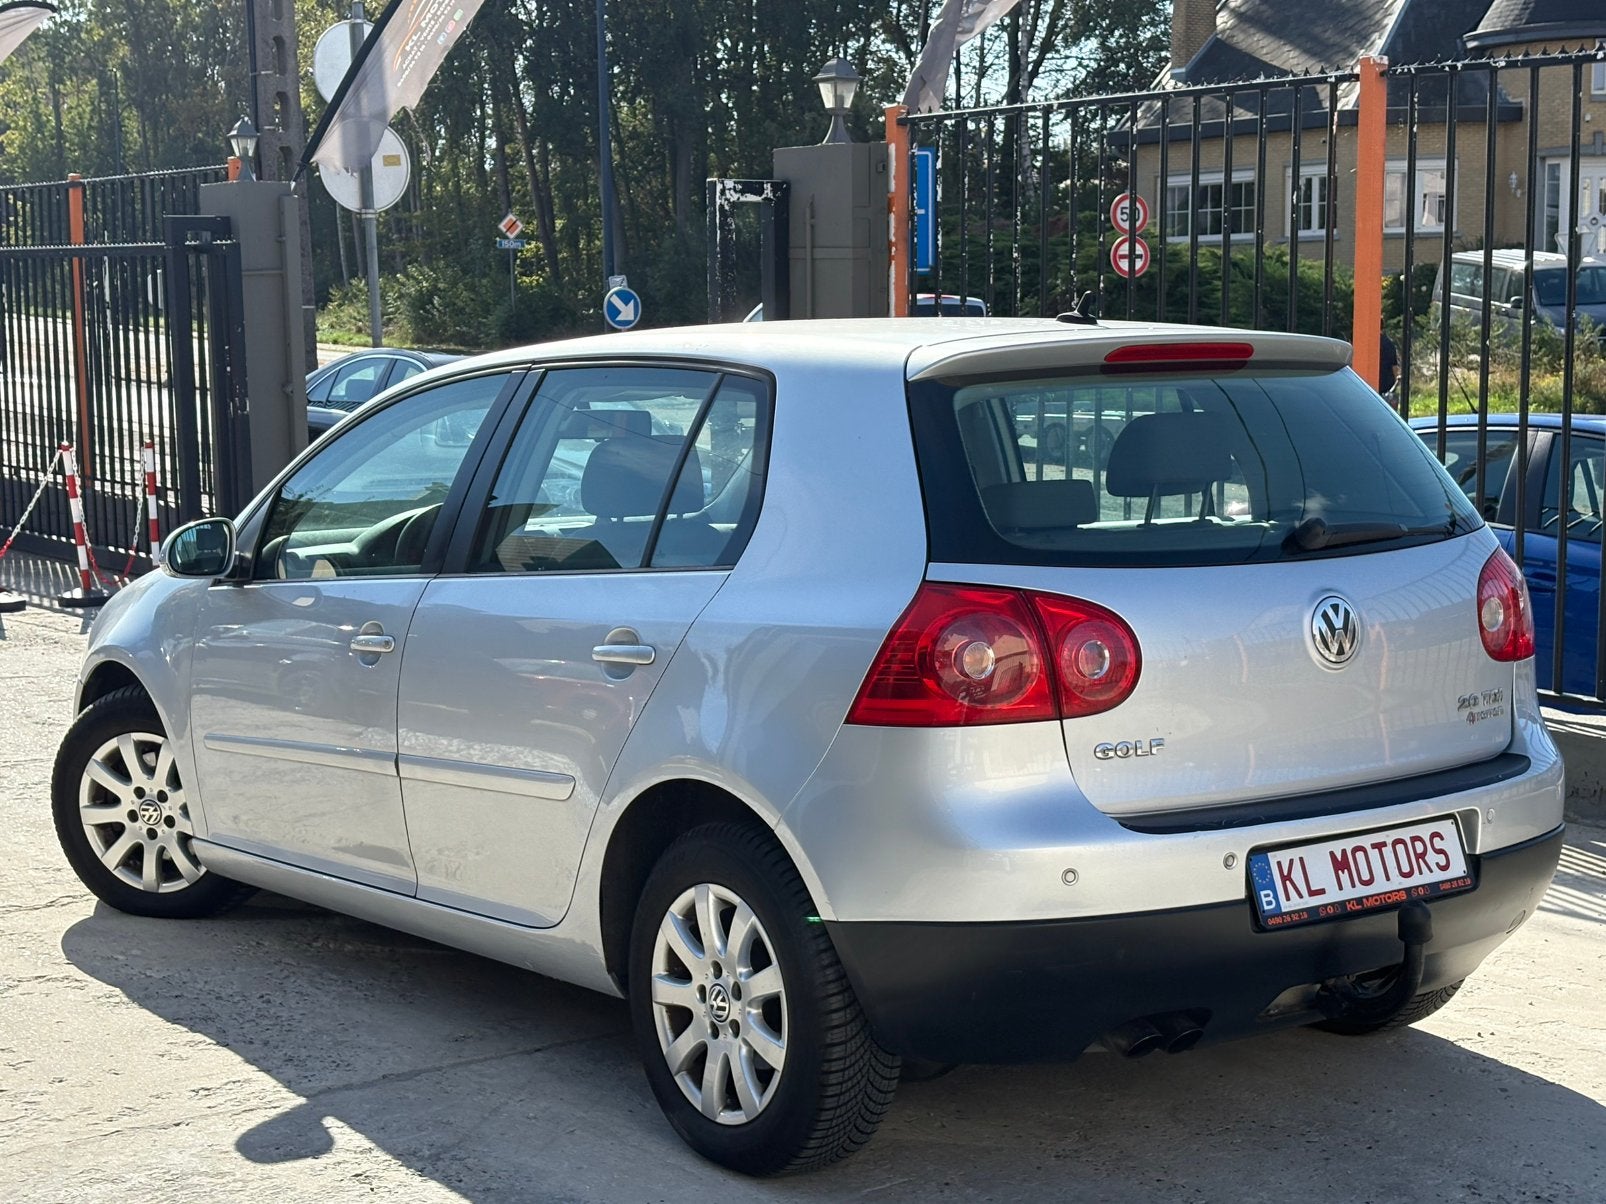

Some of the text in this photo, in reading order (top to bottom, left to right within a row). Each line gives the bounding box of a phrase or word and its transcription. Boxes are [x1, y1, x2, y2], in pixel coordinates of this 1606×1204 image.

[405, 32, 421, 51] KL
[1094, 738, 1165, 760] GOLF
[1277, 831, 1451, 901] KL MOTORS
[1260, 889, 1276, 910] B
[1346, 890, 1407, 911] KL MOTORS
